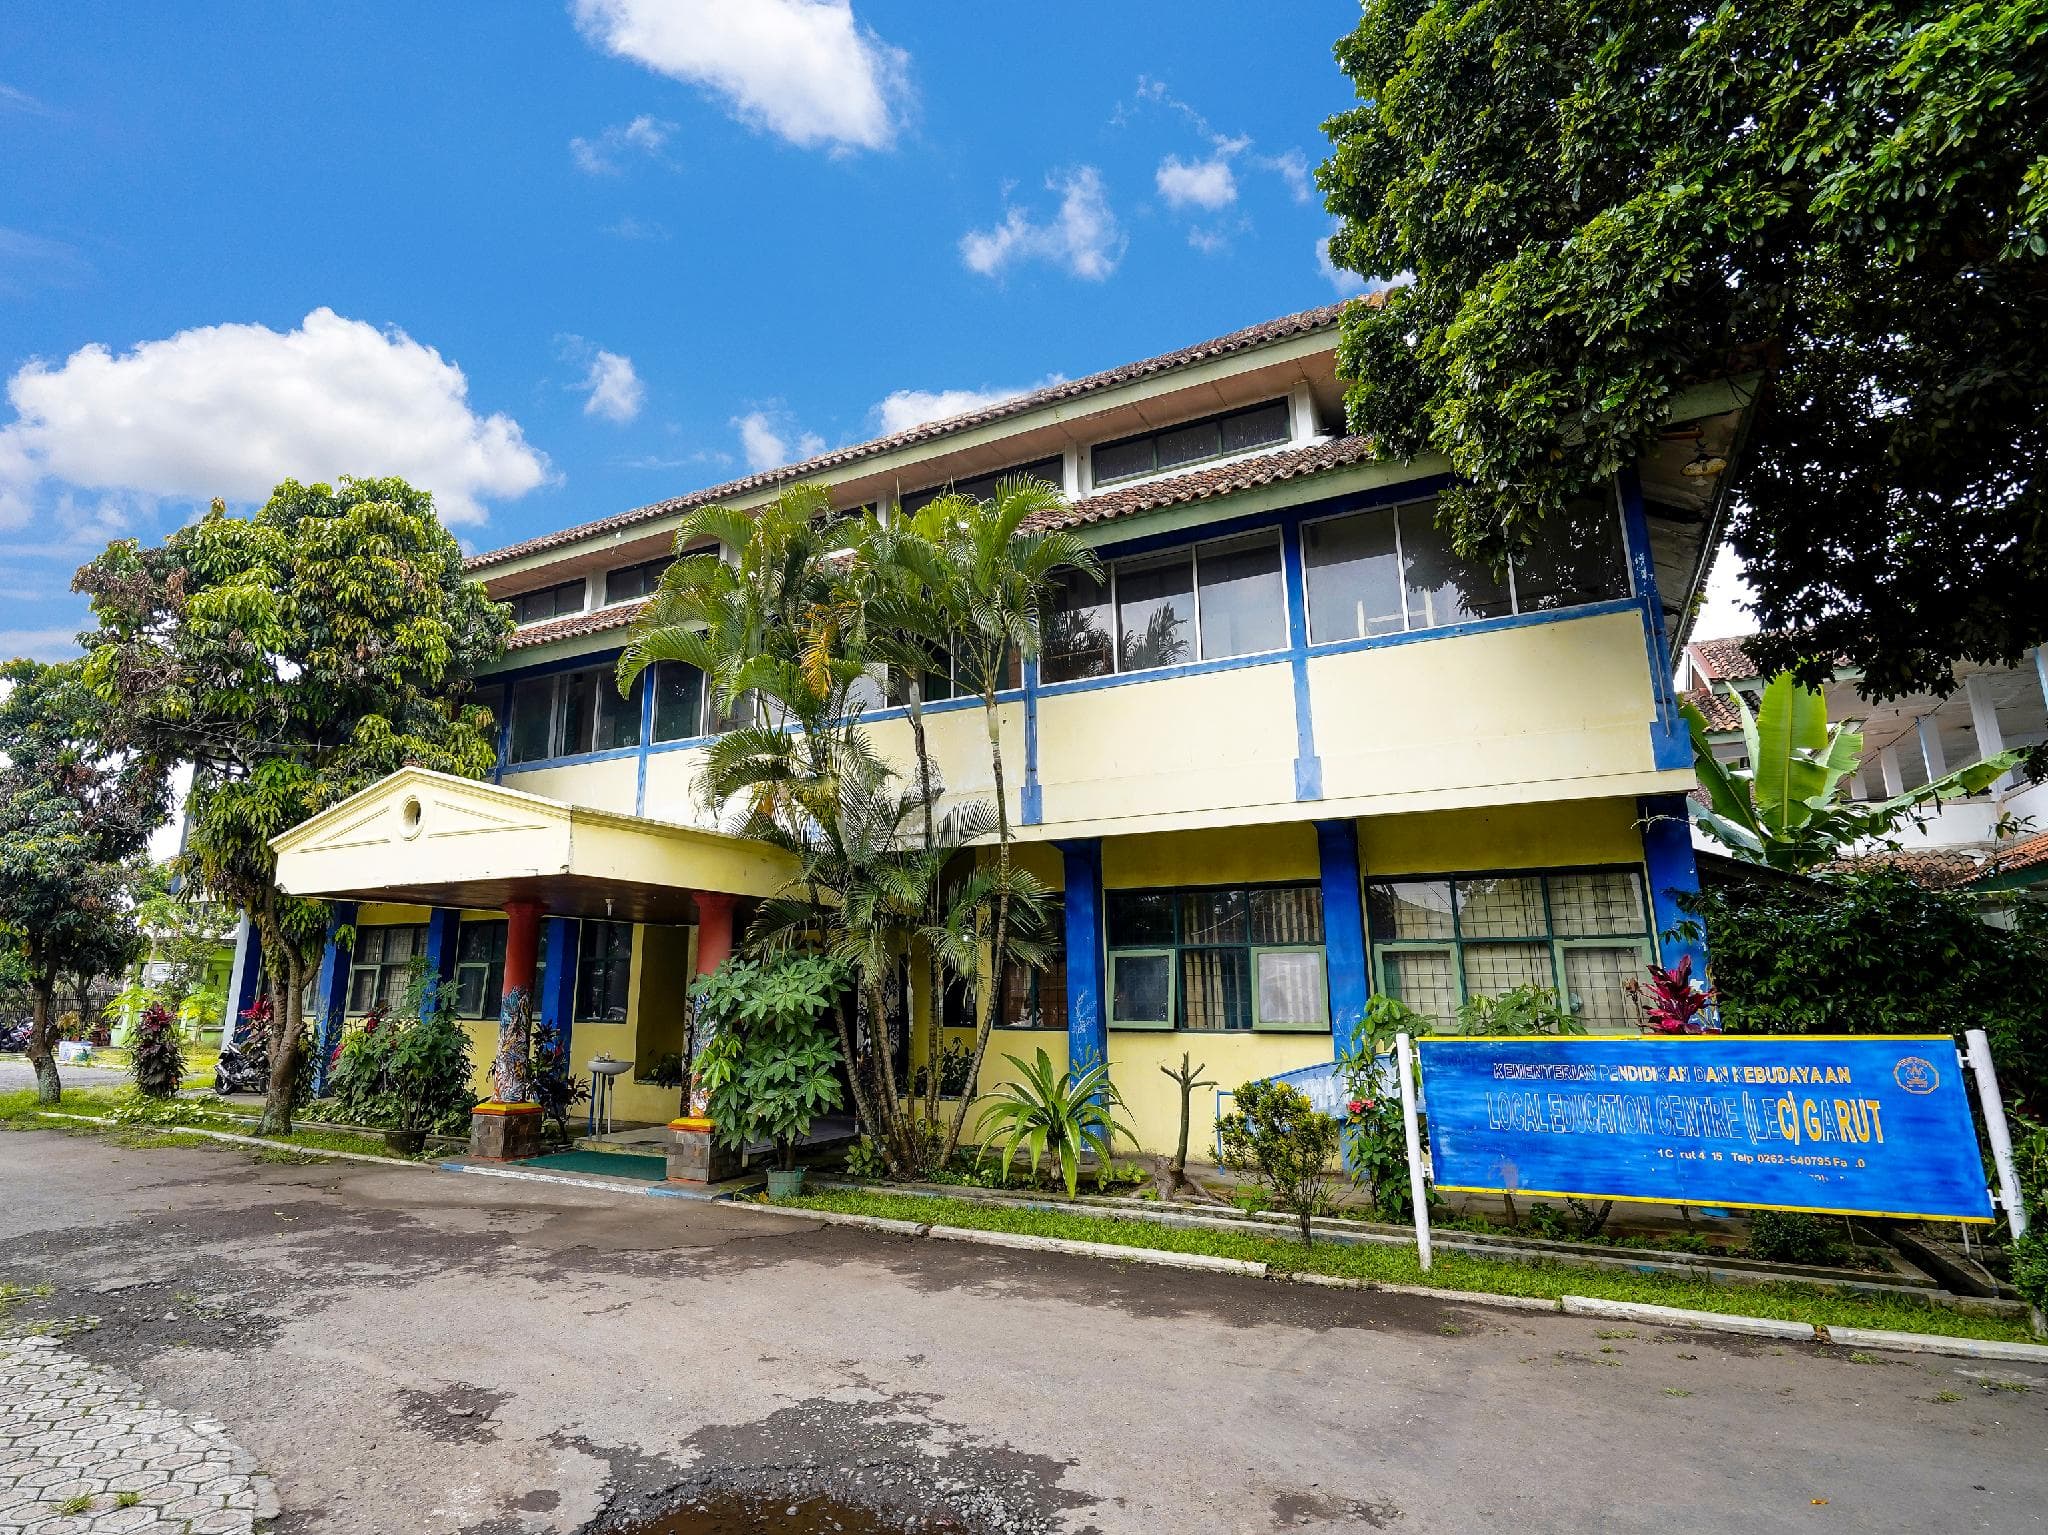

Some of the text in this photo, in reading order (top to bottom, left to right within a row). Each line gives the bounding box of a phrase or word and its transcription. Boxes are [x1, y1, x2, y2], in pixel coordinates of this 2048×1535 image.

[1494, 1063, 1852, 1084] KEMENTERIAN PENDIDIKAN DAN KEBUDAYAAN
[1486, 1091, 1548, 1132] LOCAL
[1548, 1094, 1654, 1135] EDUCATION
[1655, 1095, 1742, 1139] CENTRE
[1803, 1097, 1884, 1144] GARUT
